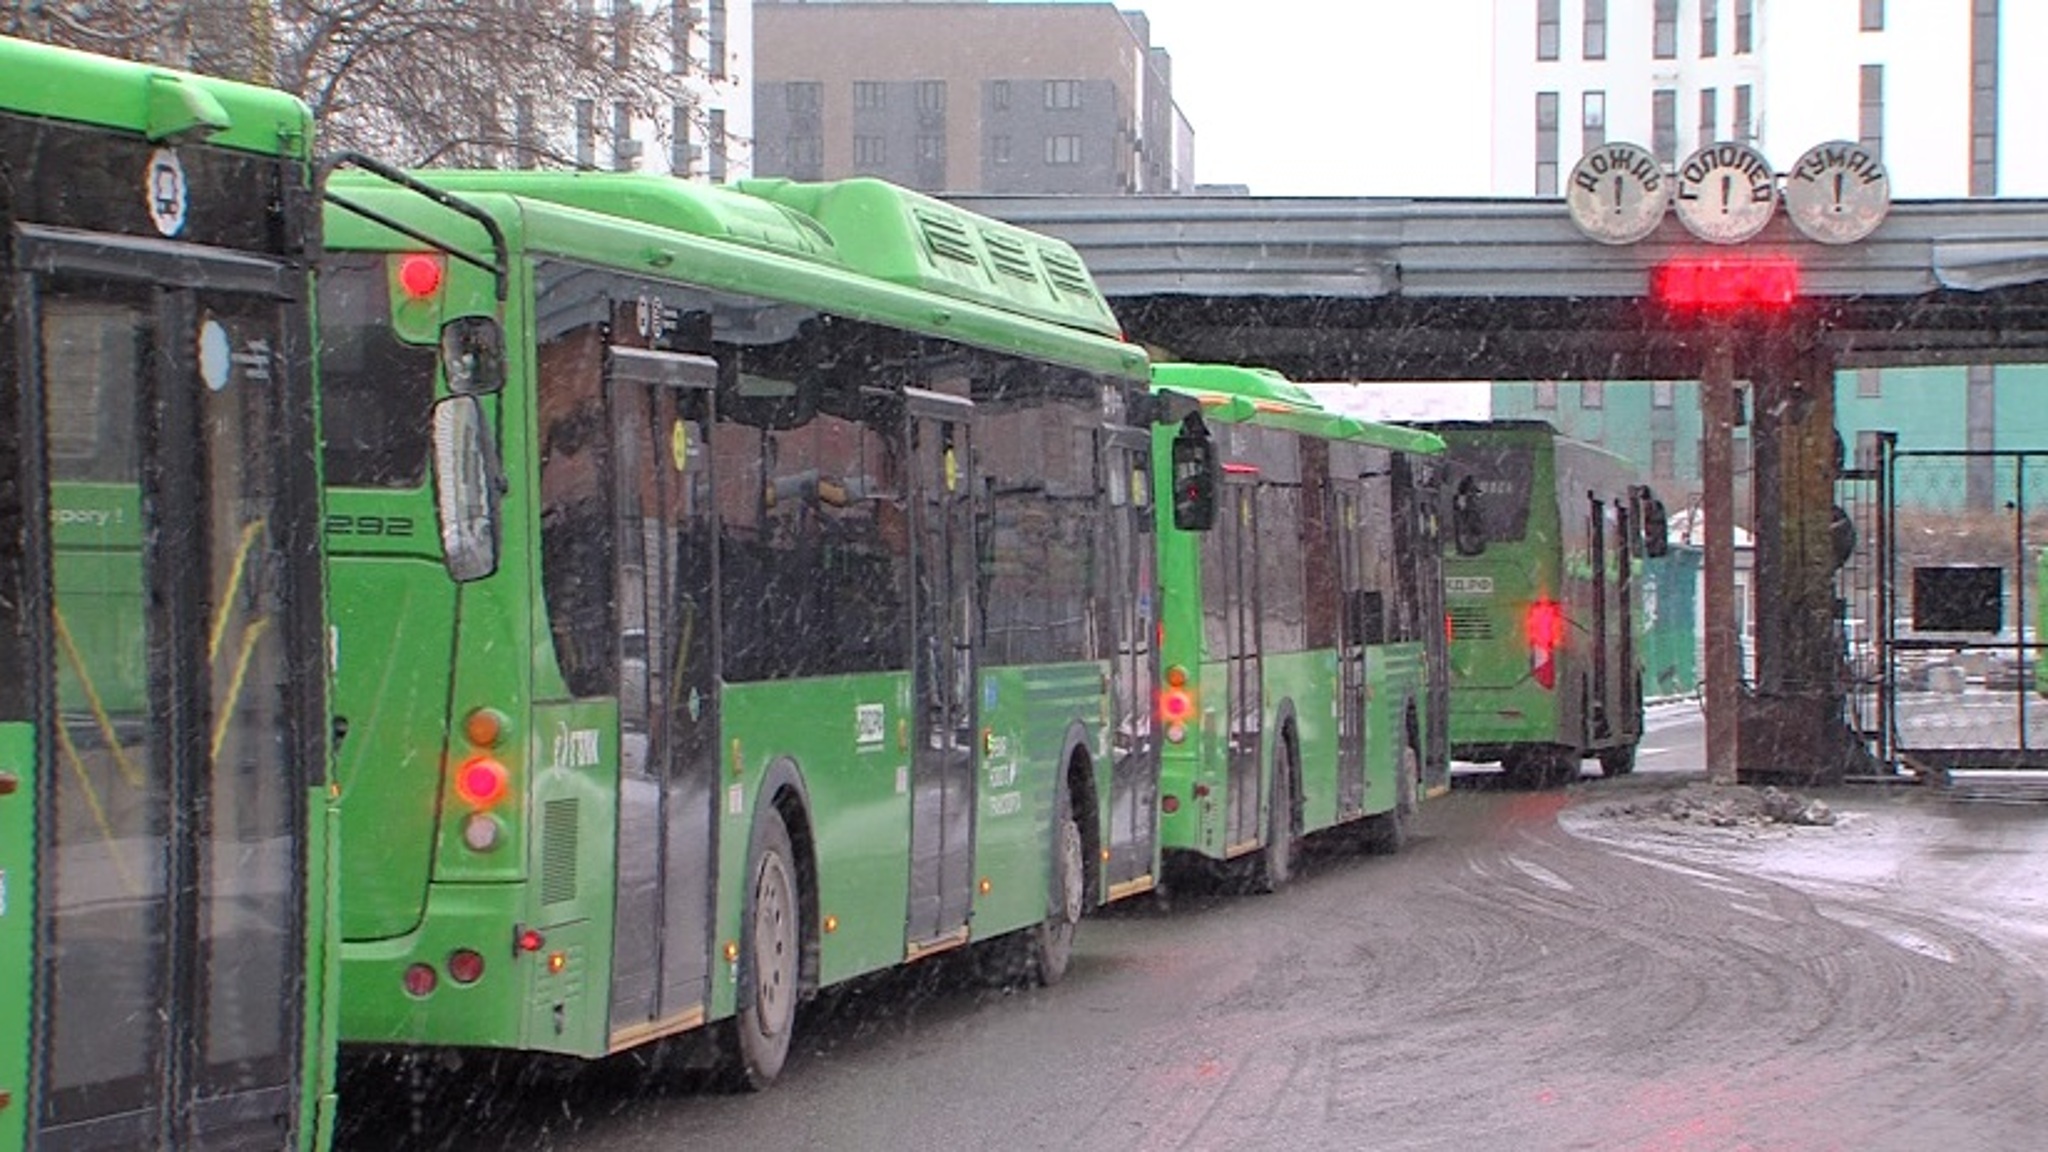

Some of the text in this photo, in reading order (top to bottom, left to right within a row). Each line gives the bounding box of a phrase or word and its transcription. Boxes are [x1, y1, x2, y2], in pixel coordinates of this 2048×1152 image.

[1576, 150, 1660, 193] ДОЖДЬ
[1678, 146, 1772, 204] ГОЛОЛЕД
[1794, 147, 1883, 185] ТУМАН
[326, 514, 414, 536] 292
